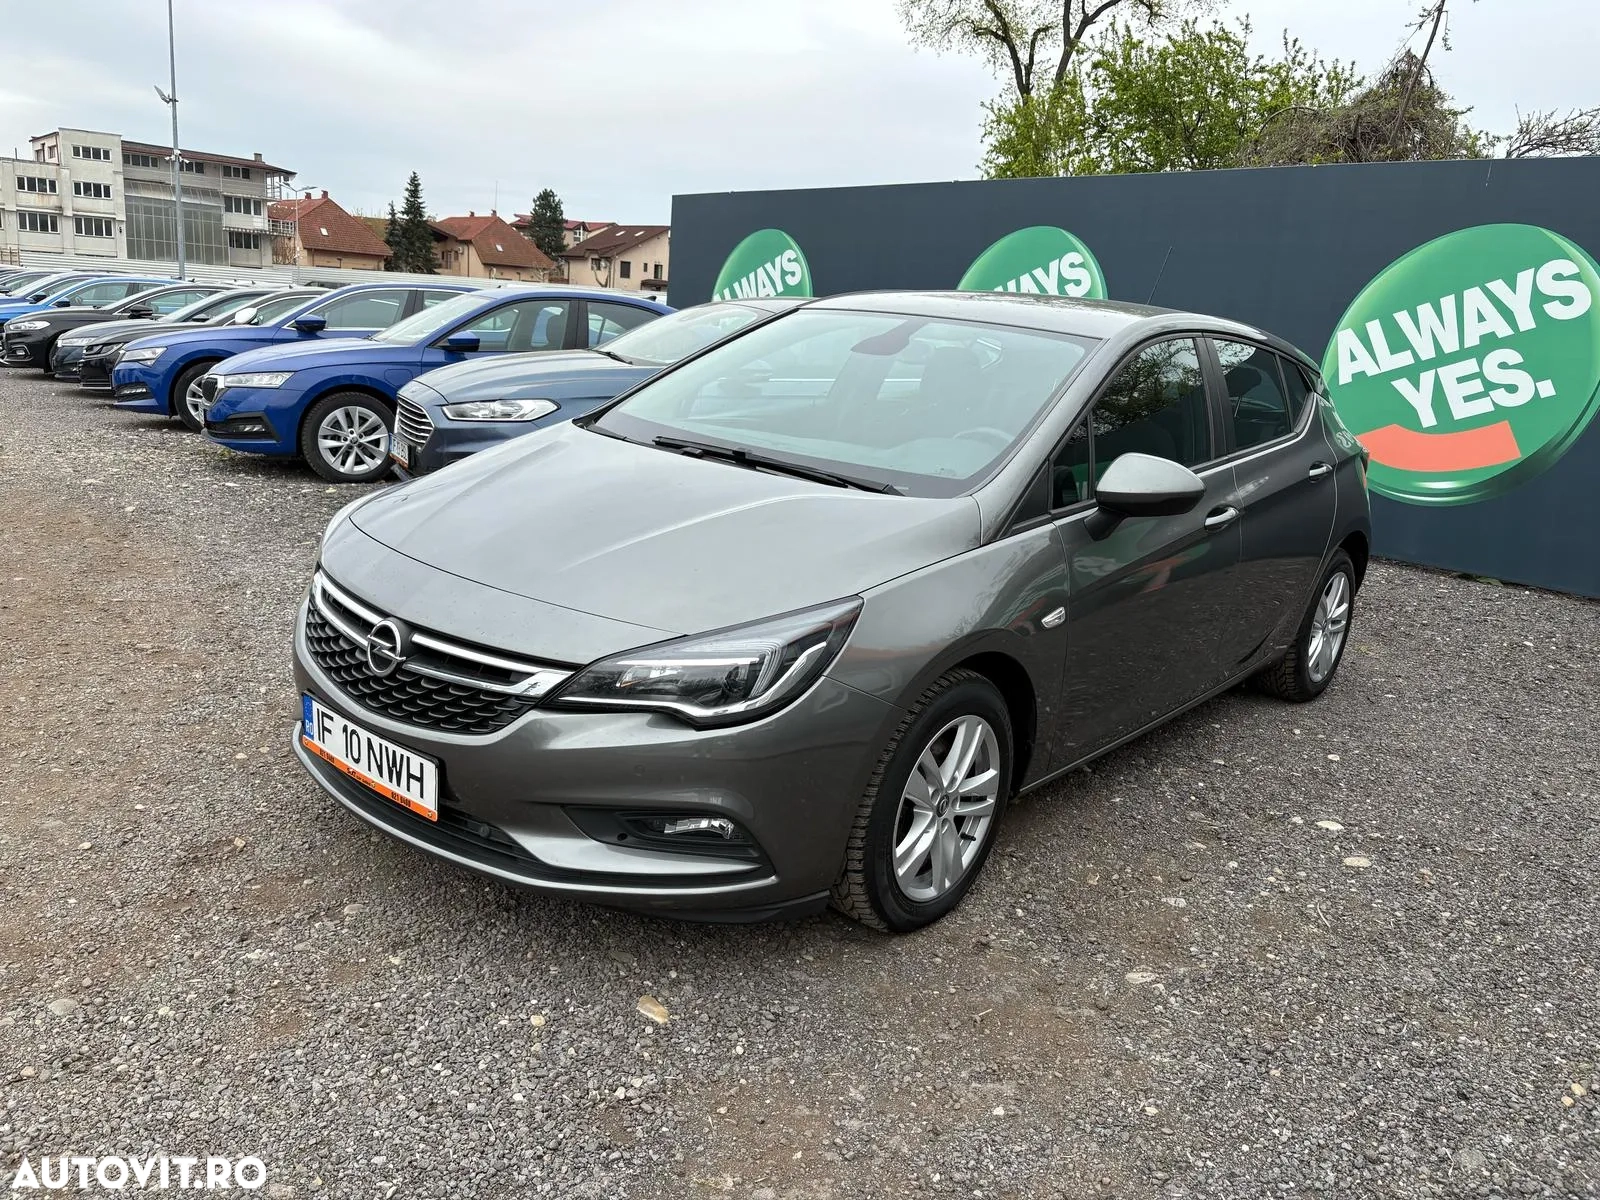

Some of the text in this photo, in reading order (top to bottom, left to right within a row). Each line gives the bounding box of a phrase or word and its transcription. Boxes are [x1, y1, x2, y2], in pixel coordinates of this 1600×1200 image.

[1337, 258, 1592, 386] ALWAYS
[1390, 348, 1557, 429] YES.
[305, 720, 314, 735] RO
[316, 708, 334, 744] IF
[342, 723, 361, 764] 10
[366, 736, 424, 799] NWH
